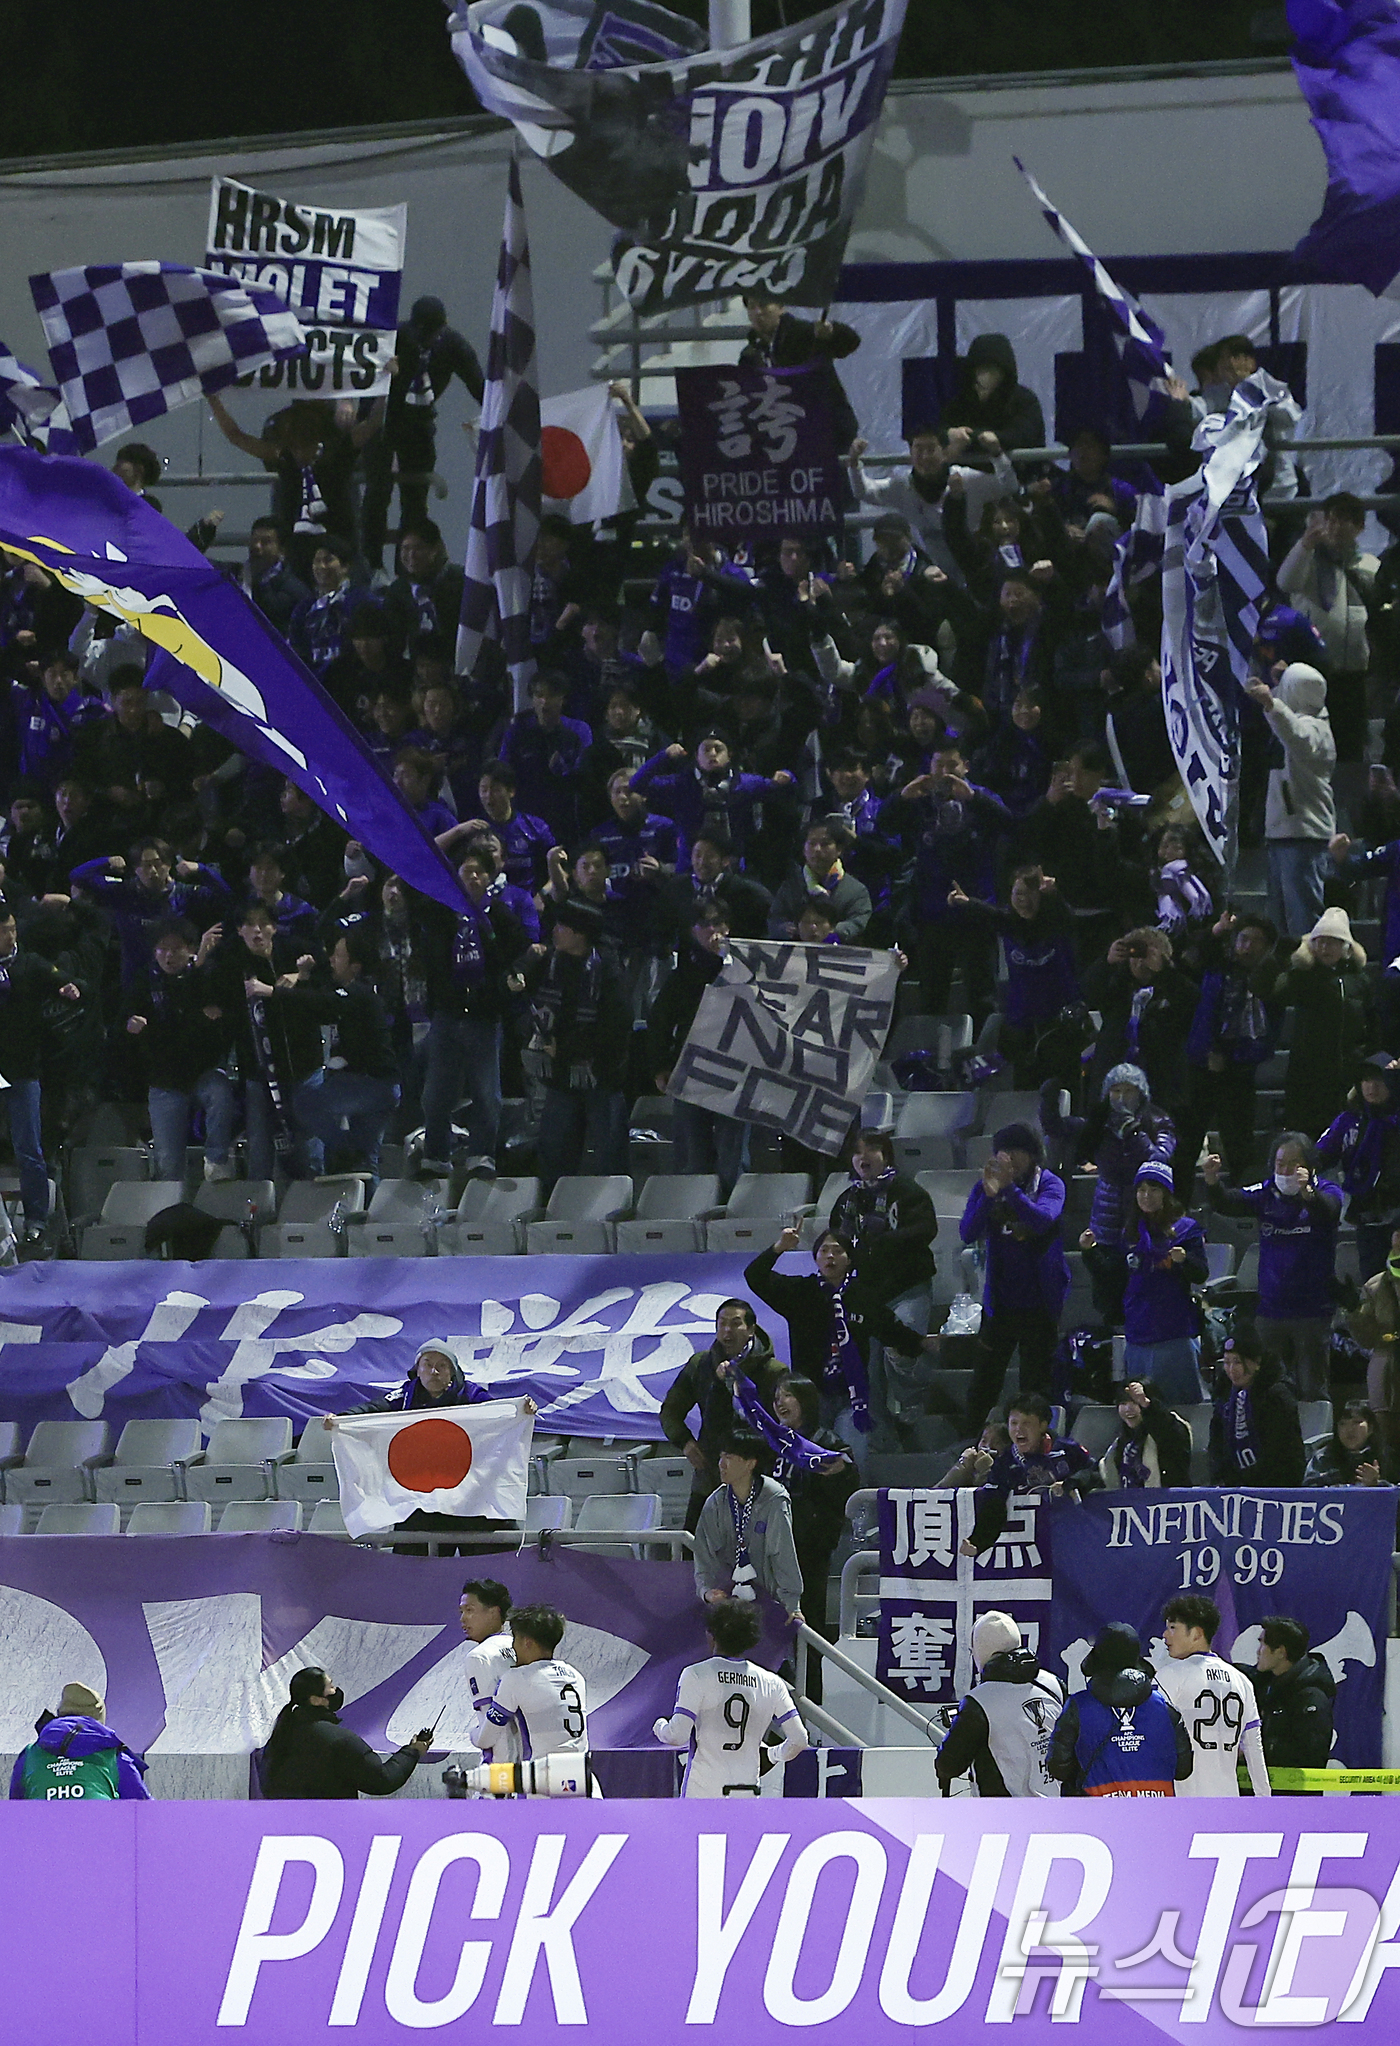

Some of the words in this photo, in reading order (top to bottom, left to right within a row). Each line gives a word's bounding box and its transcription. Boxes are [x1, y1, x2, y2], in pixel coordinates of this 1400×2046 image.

[214, 186, 356, 259] HRSM
[210, 260, 380, 323] OLET
[703, 469, 779, 498] PRIDE
[790, 467, 824, 494] OF
[693, 497, 836, 527] HIROSHIMA
[1106, 1493, 1344, 1548] INFINITIES
[717, 1671, 757, 1688] GERMAIN
[1205, 1668, 1231, 1683] AKITO
[559, 1683, 585, 1738] 3
[722, 1693, 750, 1751] 9
[1193, 1689, 1245, 1752] 29
[1111, 1735, 1146, 1743] CHAMPIONS
[1118, 1740, 1141, 1748] LEAGUE
[216, 1831, 630, 2028] PICK
[685, 1830, 1114, 2026] YOUR
